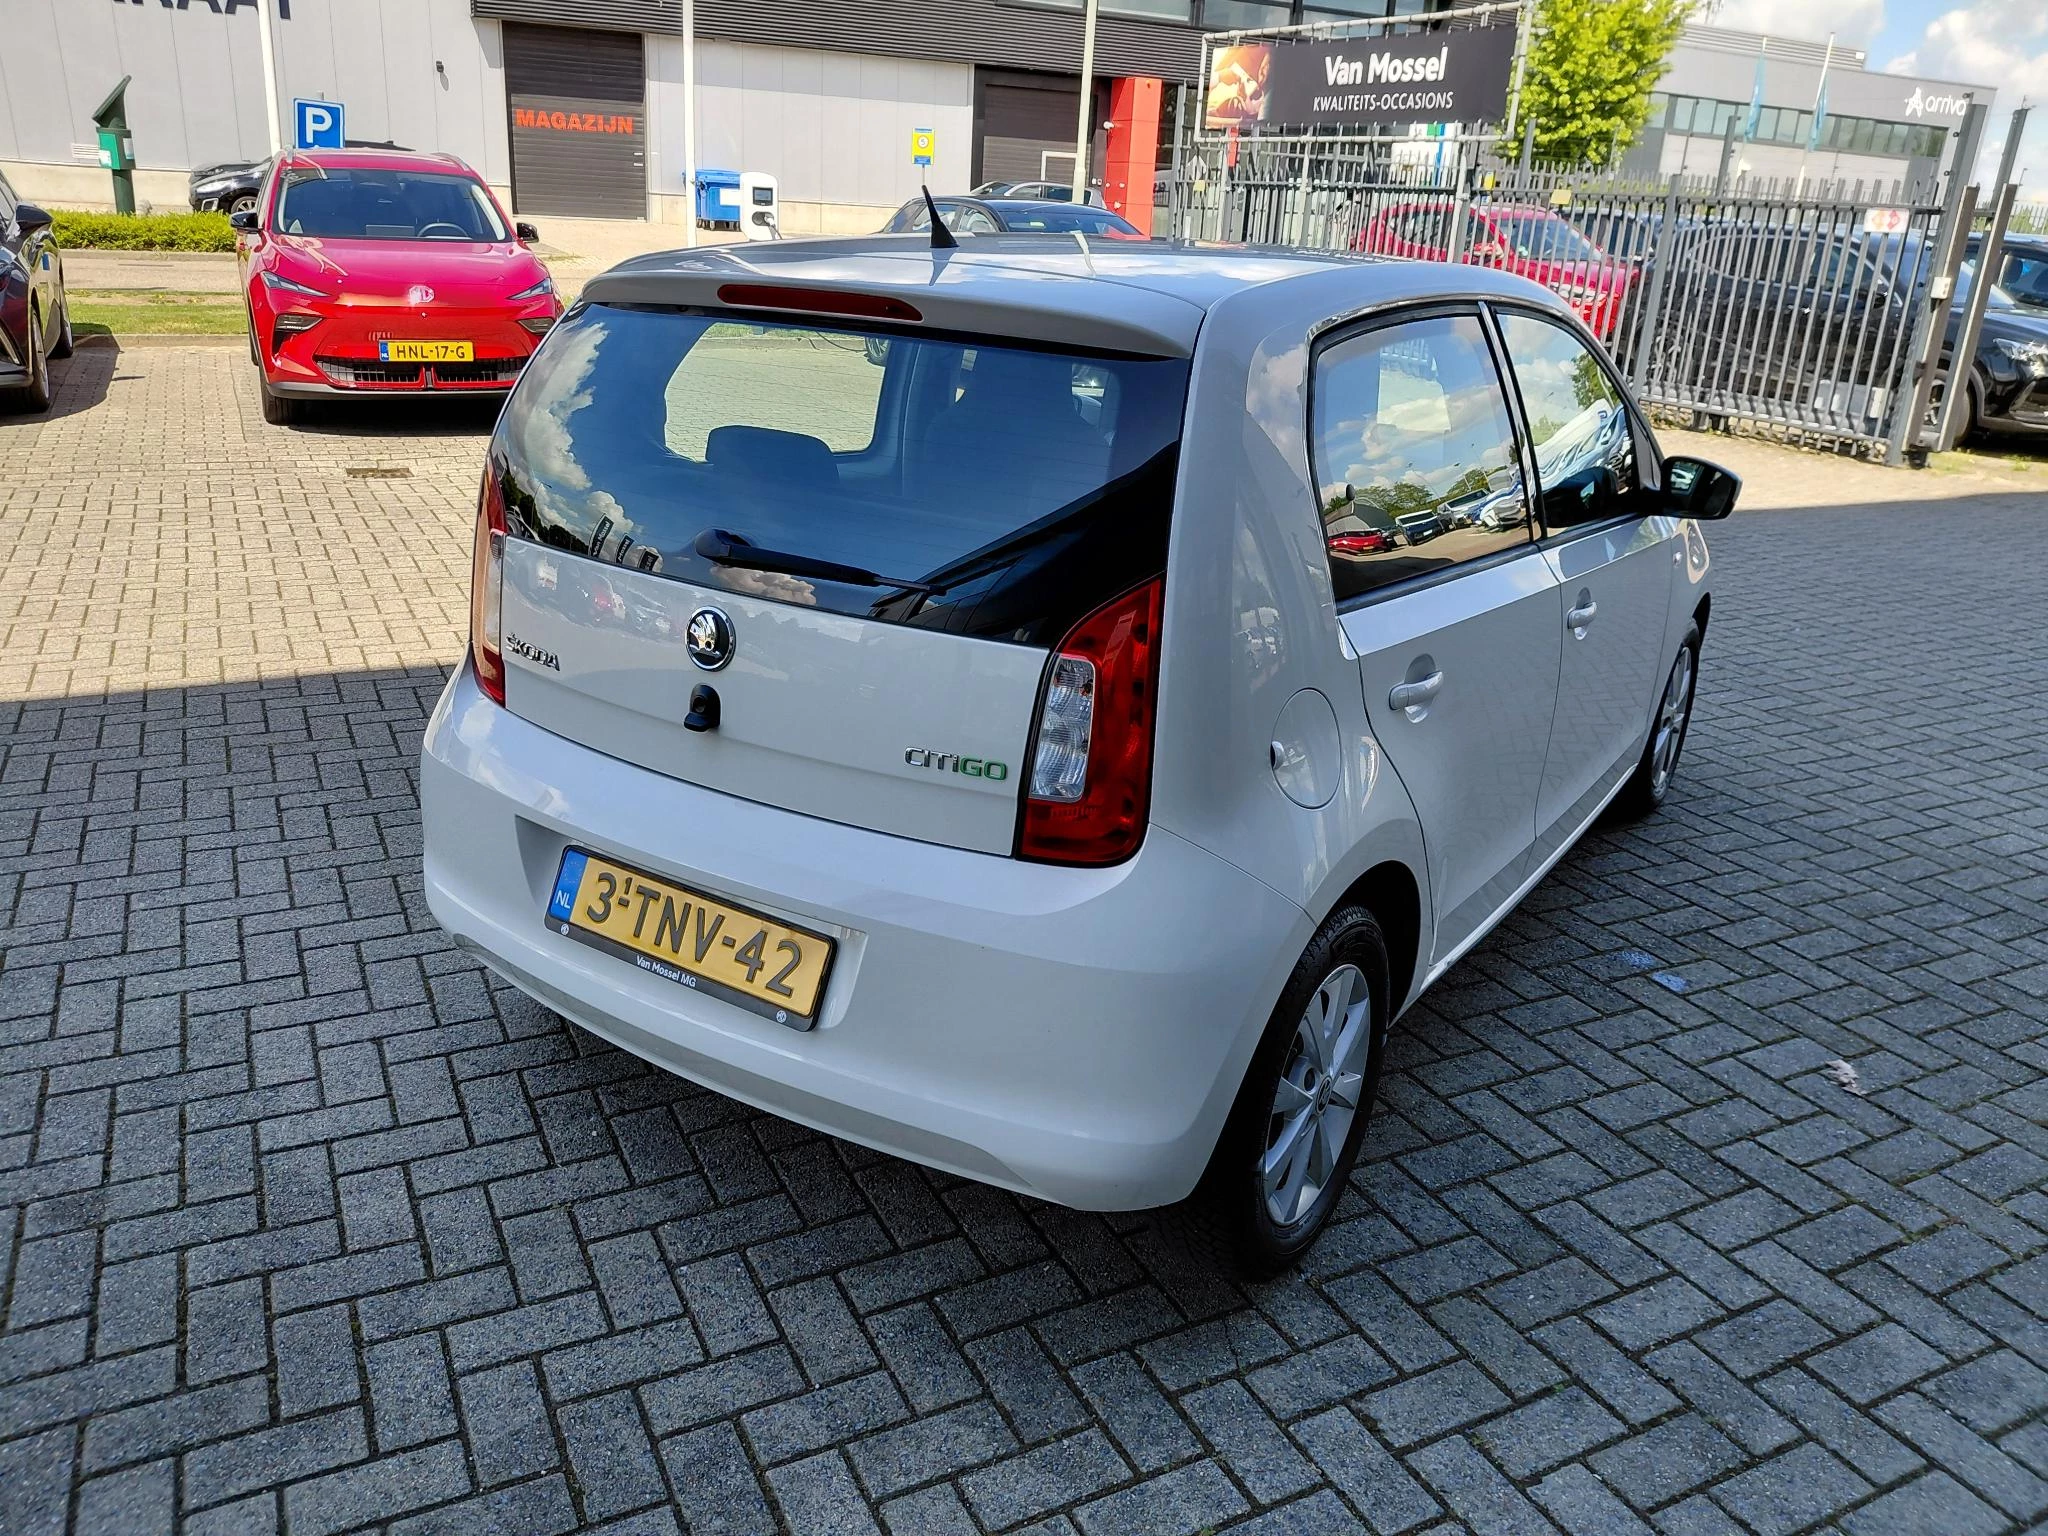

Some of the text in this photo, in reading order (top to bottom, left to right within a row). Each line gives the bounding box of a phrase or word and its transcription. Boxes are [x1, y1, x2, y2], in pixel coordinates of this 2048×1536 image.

[1324, 46, 1449, 86] Van Mossel
[1312, 91, 1454, 112] KWALITEITS-OCCASIONS
[305, 106, 333, 144] P
[515, 108, 634, 136] MAGAZIJN
[396, 345, 465, 359] HNL-17-G
[505, 632, 561, 672] ŠKODA
[555, 889, 571, 910] NL
[635, 954, 697, 988] Van Mossel MG
